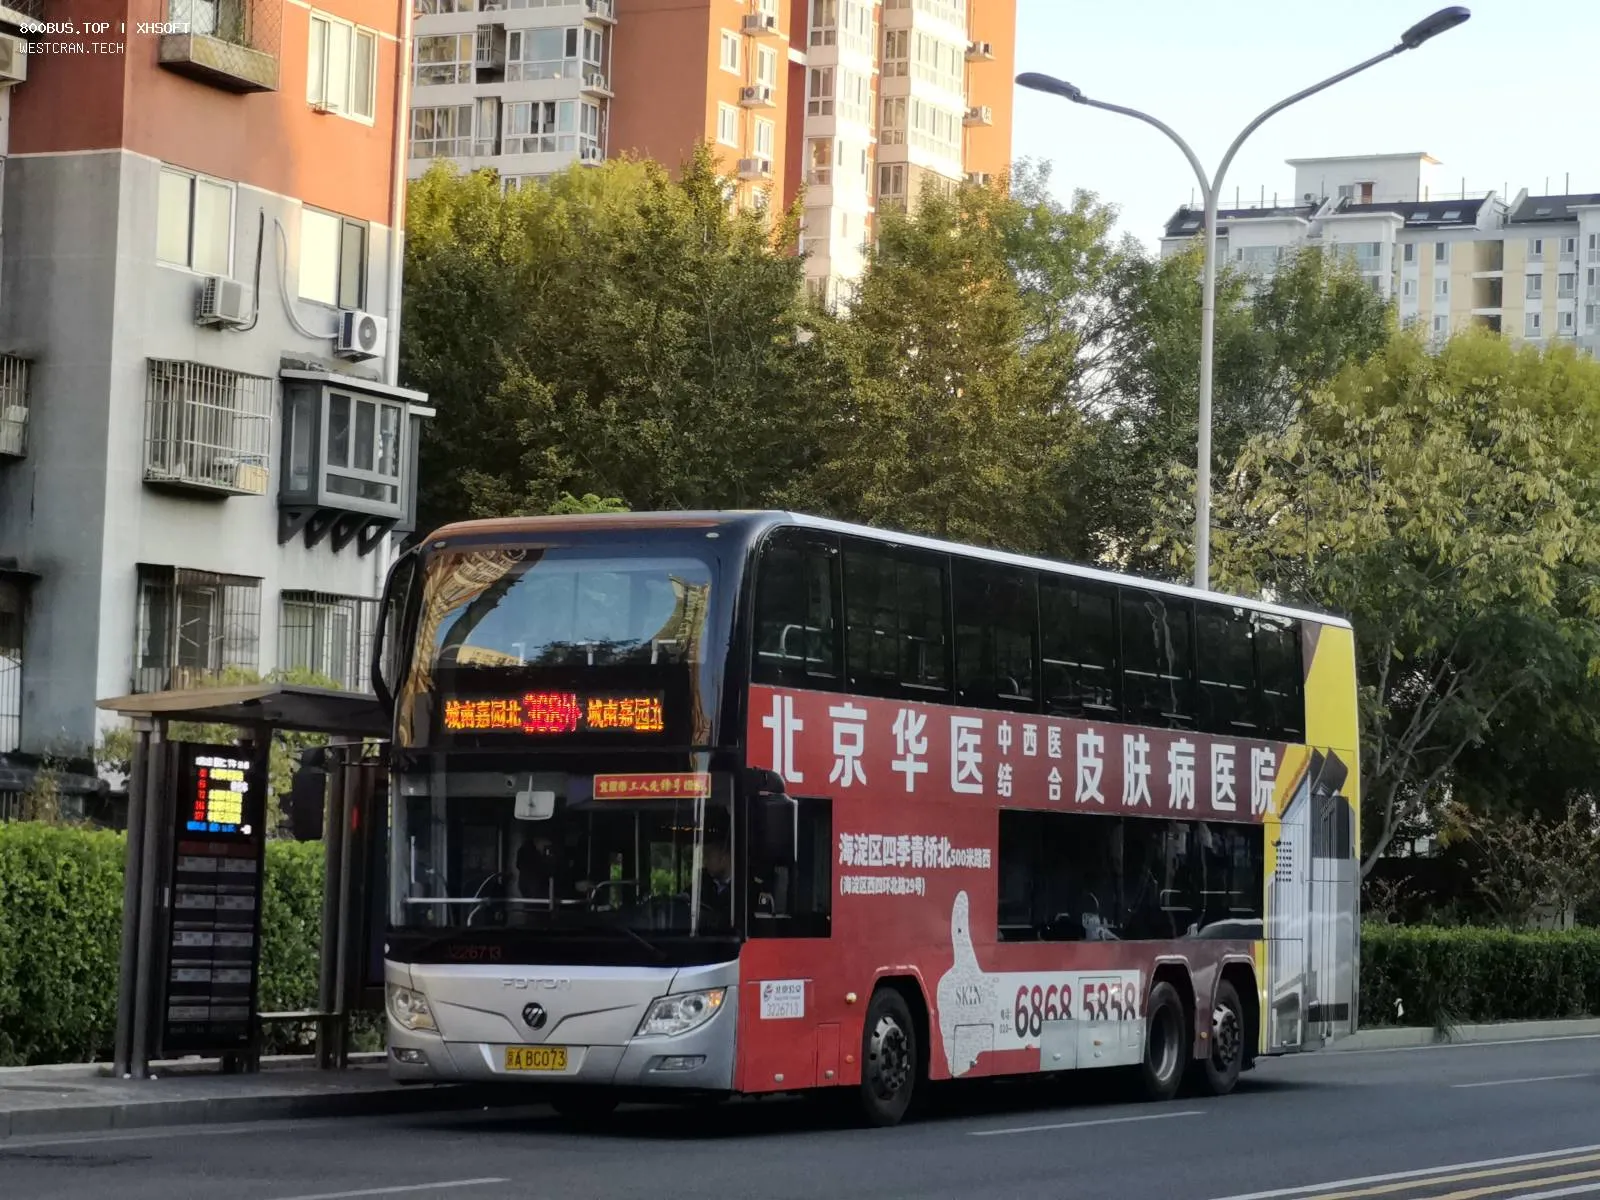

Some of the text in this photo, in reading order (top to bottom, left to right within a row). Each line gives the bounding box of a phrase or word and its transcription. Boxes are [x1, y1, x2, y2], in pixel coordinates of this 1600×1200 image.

[762, 694, 983, 795] 北京华医
[997, 719, 1062, 759] 中西医
[997, 763, 1063, 801] 结合
[1076, 728, 1278, 815] 皮肤病医院
[500, 977, 572, 991] FOTON
